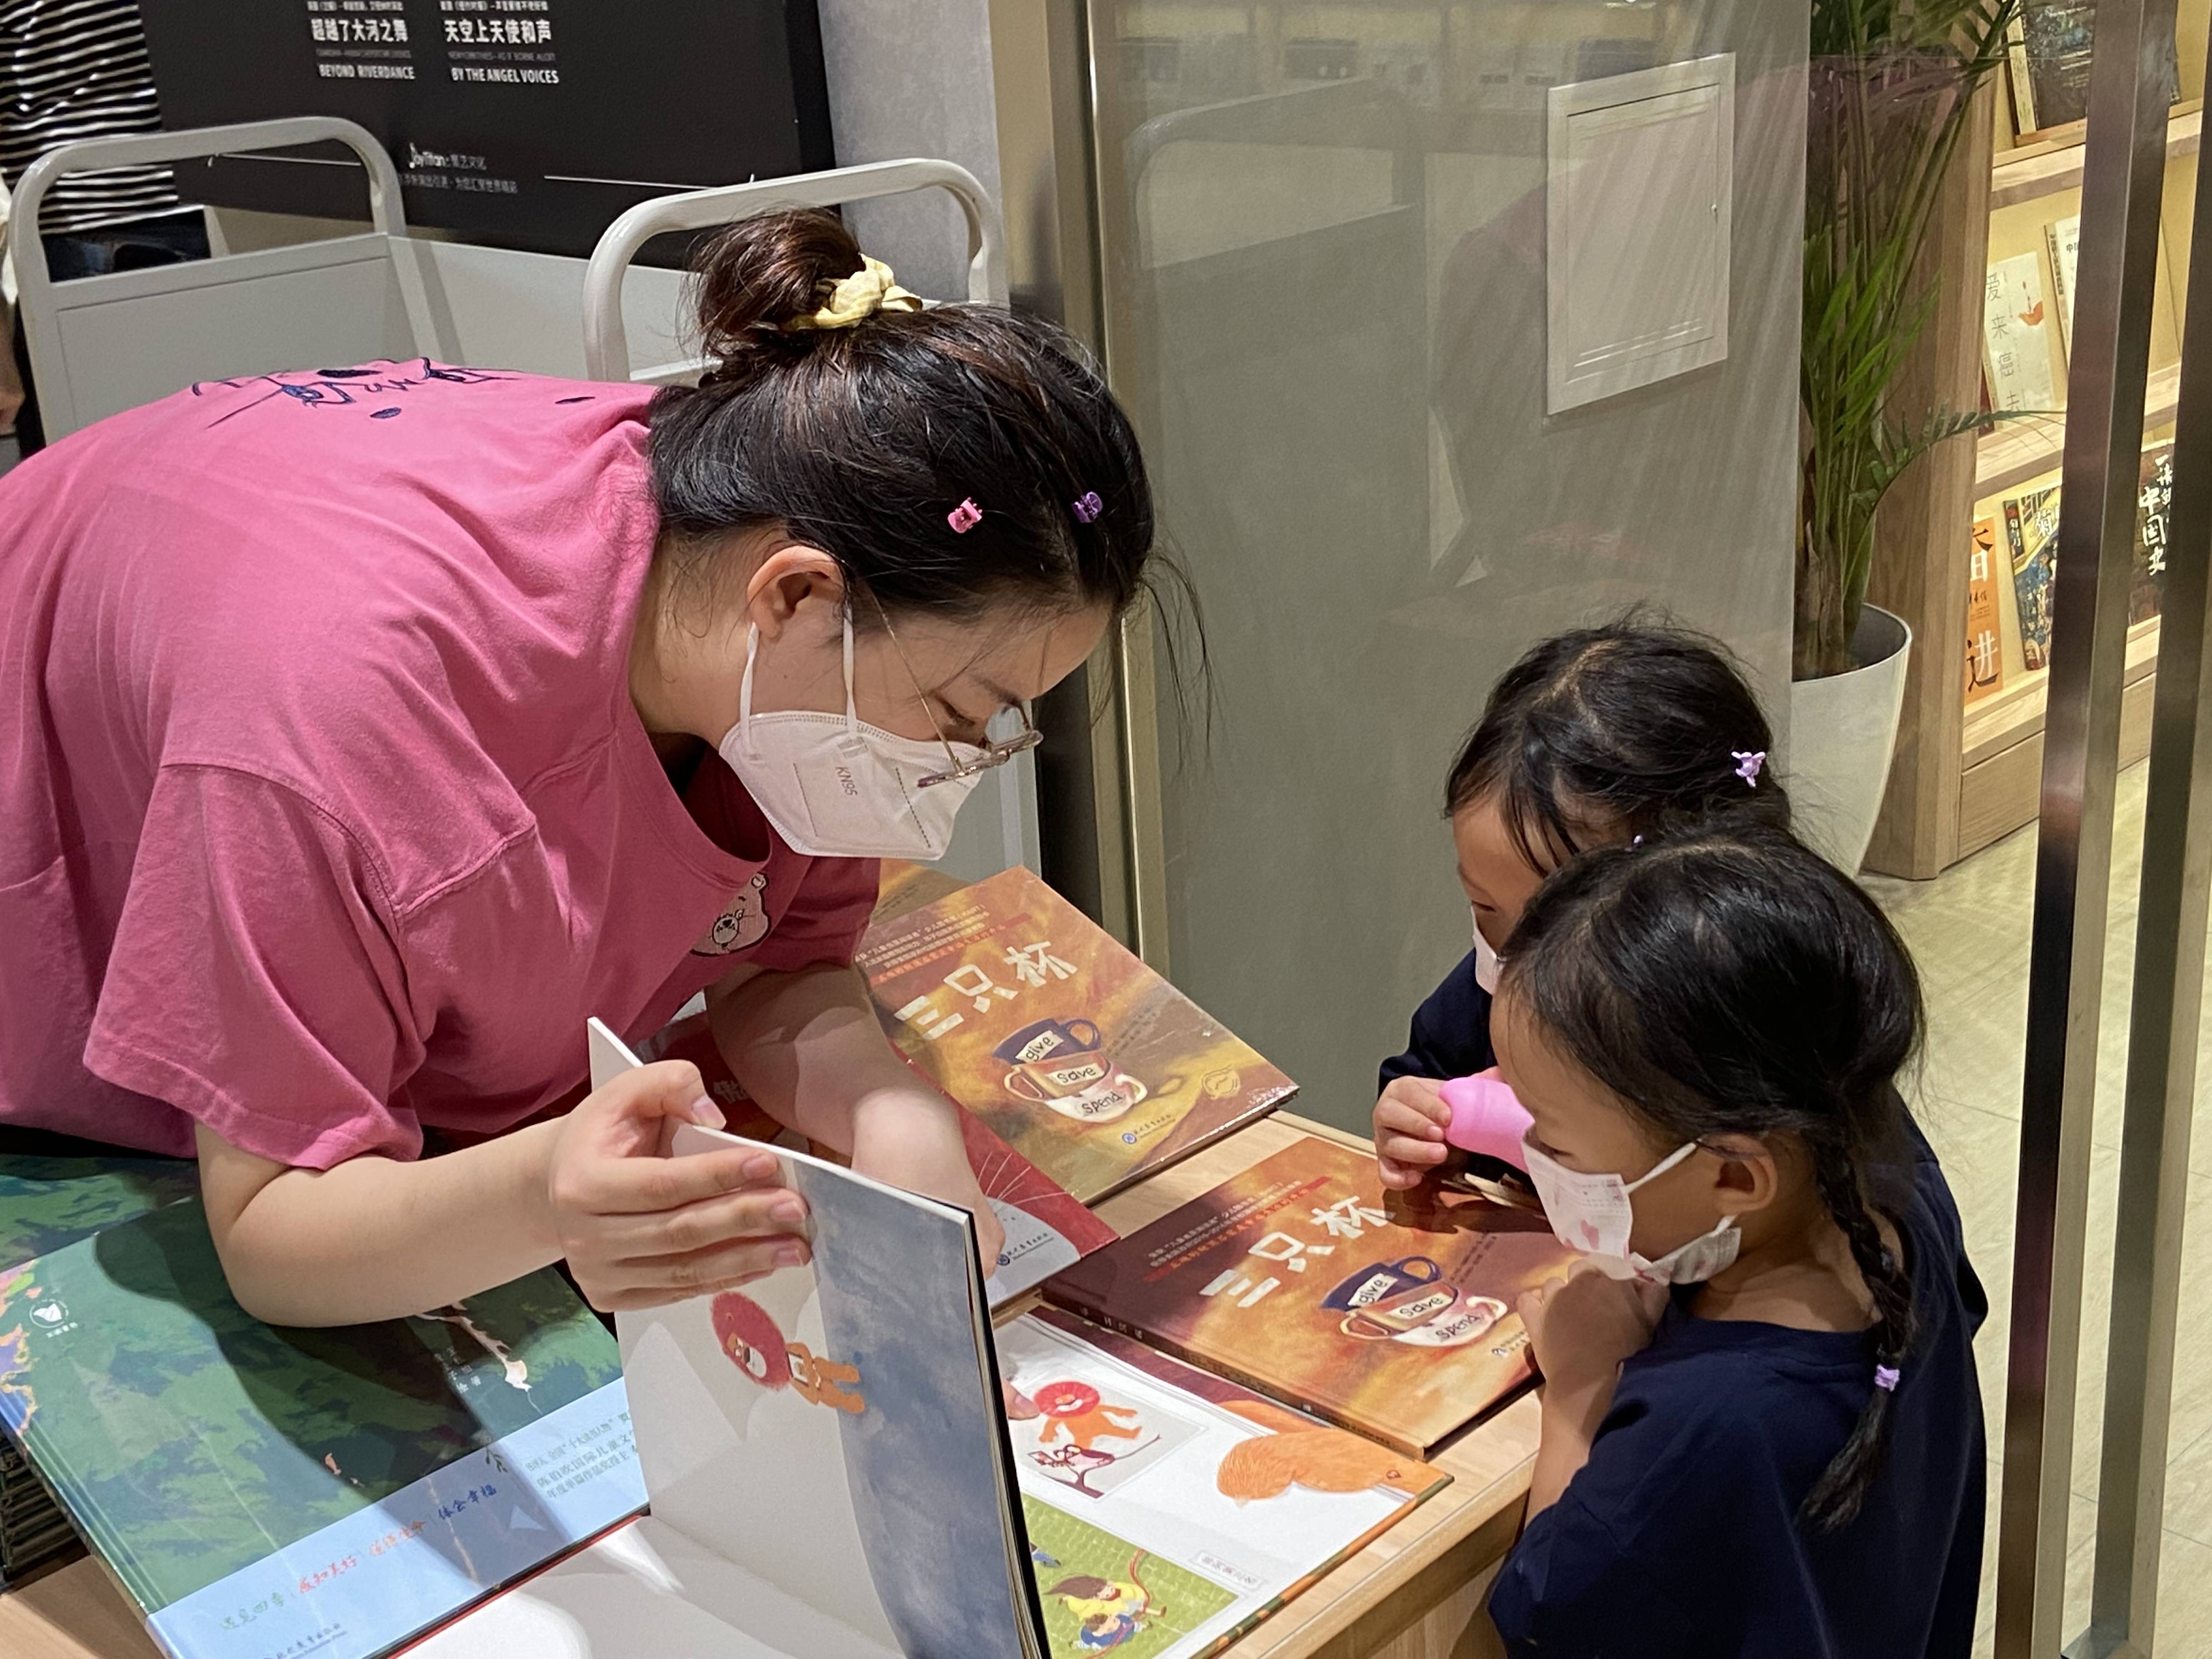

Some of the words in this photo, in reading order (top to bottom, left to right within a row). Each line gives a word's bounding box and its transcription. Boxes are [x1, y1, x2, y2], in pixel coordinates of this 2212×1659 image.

[311, 18, 409, 42] 超越了大河之舞
[444, 19, 552, 44] 天空上天使和声
[319, 64, 356, 78] BEYOND
[357, 64, 415, 80] RIVERDANCE
[451, 67, 466, 81] BY
[466, 68, 486, 82] THE
[487, 68, 520, 83] ANGEL
[520, 69, 560, 84] VOICES
[835, 766, 858, 795] KN95
[894, 940, 1079, 1041] 三只杯
[1025, 1036, 1054, 1063] give
[1199, 1195, 1396, 1308] 三只杯
[1358, 1279, 1388, 1305] give
[438, 1483, 497, 1521] 体会幸福
